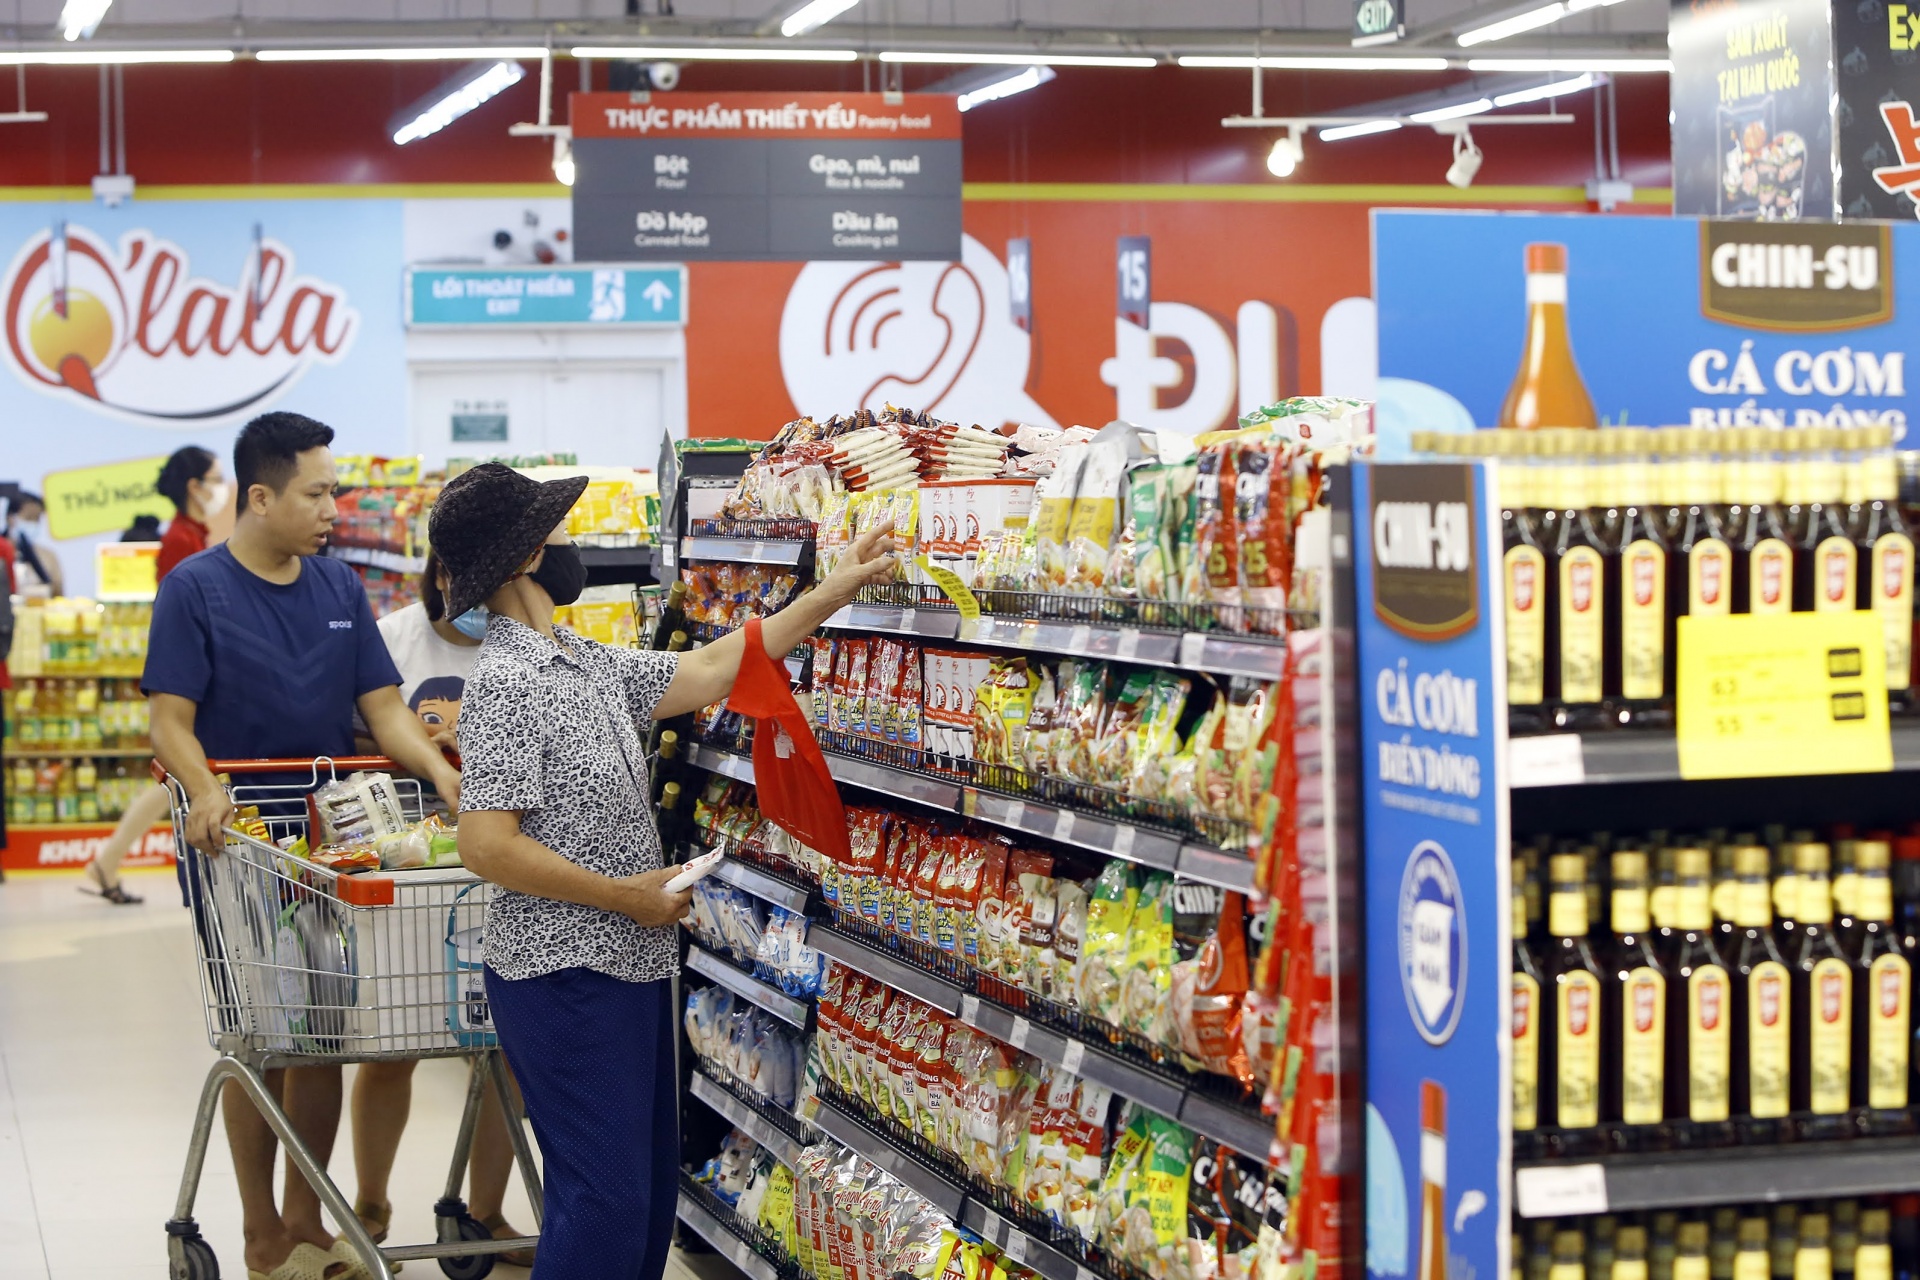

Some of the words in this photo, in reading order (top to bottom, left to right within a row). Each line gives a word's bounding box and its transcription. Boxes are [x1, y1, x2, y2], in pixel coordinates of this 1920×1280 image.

[605, 104, 669, 133] THỰC
[672, 102, 742, 129] PHẨM
[744, 102, 809, 129] THIẾT
[811, 102, 857, 130] YẾU
[858, 115, 899, 132] Pantry
[900, 114, 931, 129] food
[654, 155, 690, 178] Bột
[889, 155, 921, 174] nui
[655, 177, 688, 189] Flour
[826, 177, 850, 189] Rice
[636, 209, 666, 231] Đồ
[668, 211, 708, 235] hộp
[832, 209, 871, 231] Dầu
[873, 212, 899, 231] ăn
[681, 232, 710, 247] food
[832, 233, 882, 249] Cooking
[1008, 251, 1027, 298] 16
[1118, 251, 1147, 300] 15
[1711, 243, 1878, 290] CHIN-SU
[1688, 339, 1768, 395] CÁ
[1773, 346, 1906, 397] CƠM
[1375, 501, 1469, 571] CHIN-SU
[1376, 657, 1415, 727] CÁ
